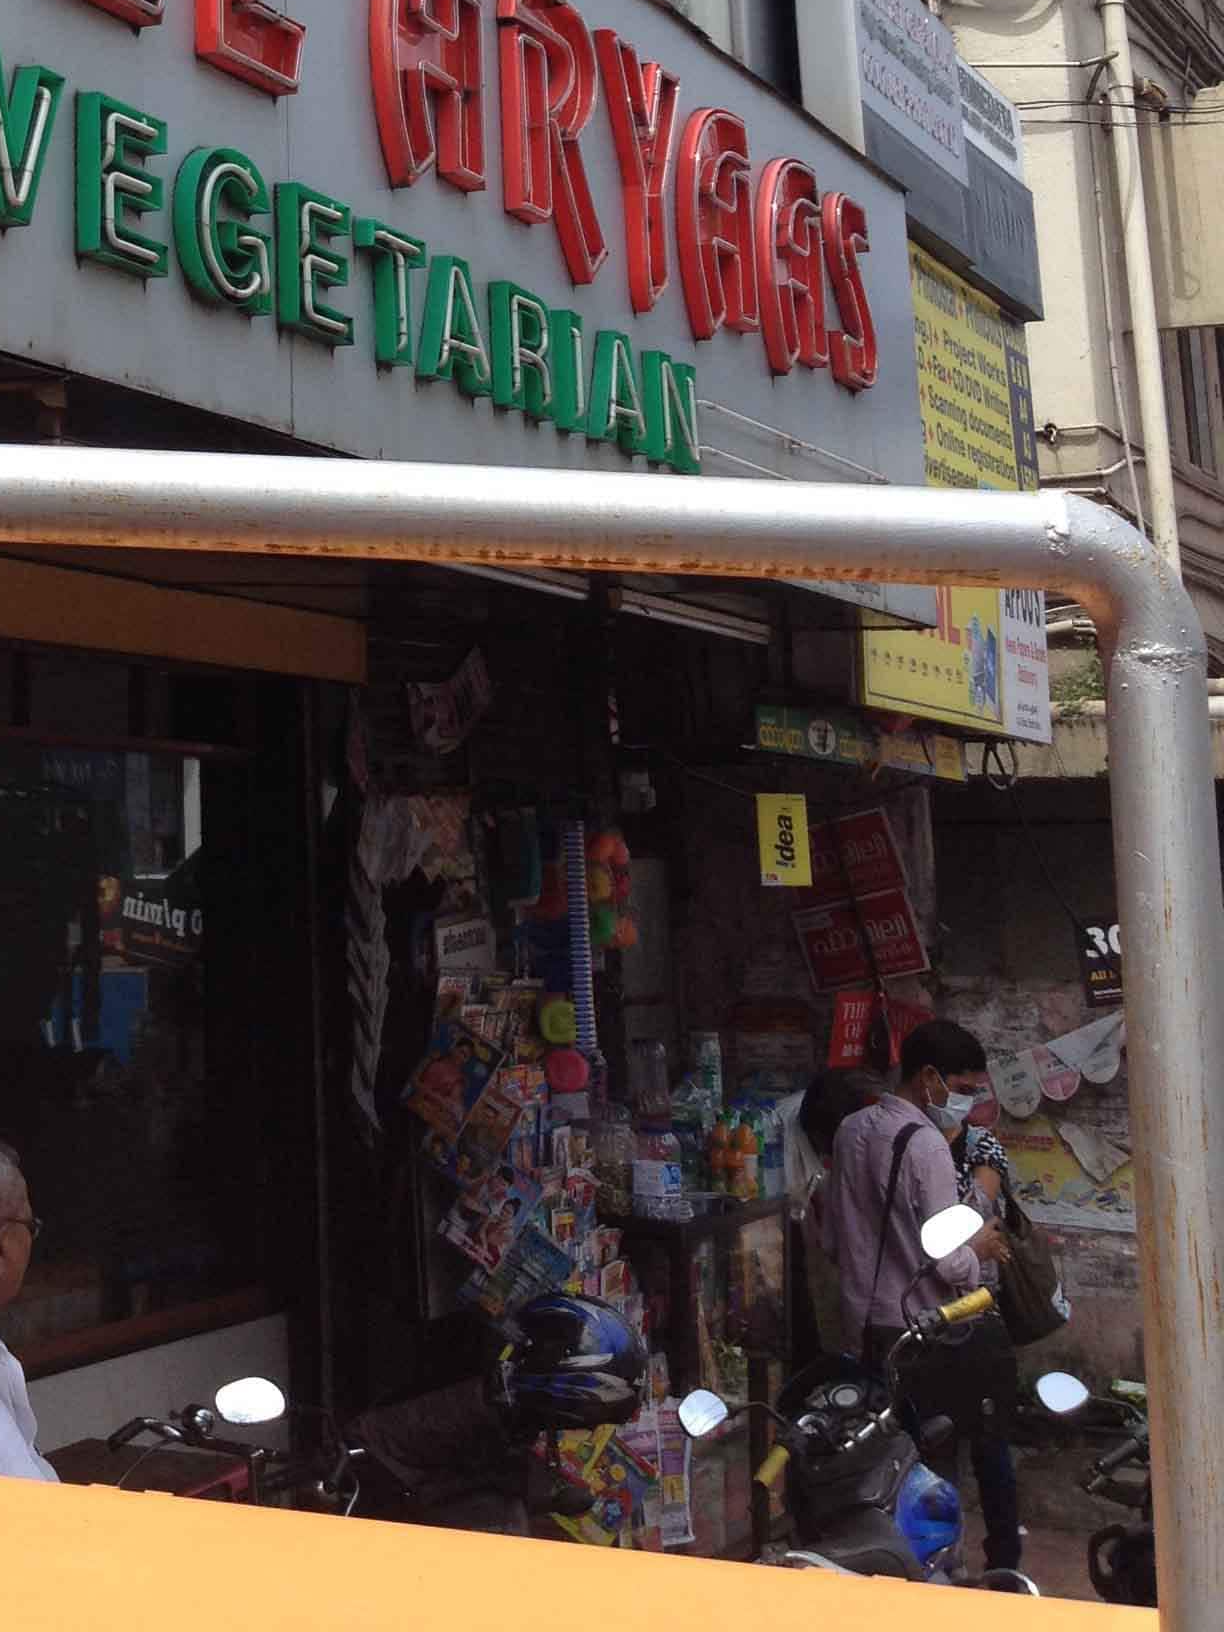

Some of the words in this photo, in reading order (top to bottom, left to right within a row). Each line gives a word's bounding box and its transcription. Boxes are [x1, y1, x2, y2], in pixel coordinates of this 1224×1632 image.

[942, 327, 976, 369] Project
[978, 350, 1007, 386] Works
[927, 384, 968, 432] Scanning
[969, 406, 1014, 450] documents
[936, 422, 966, 456] Online
